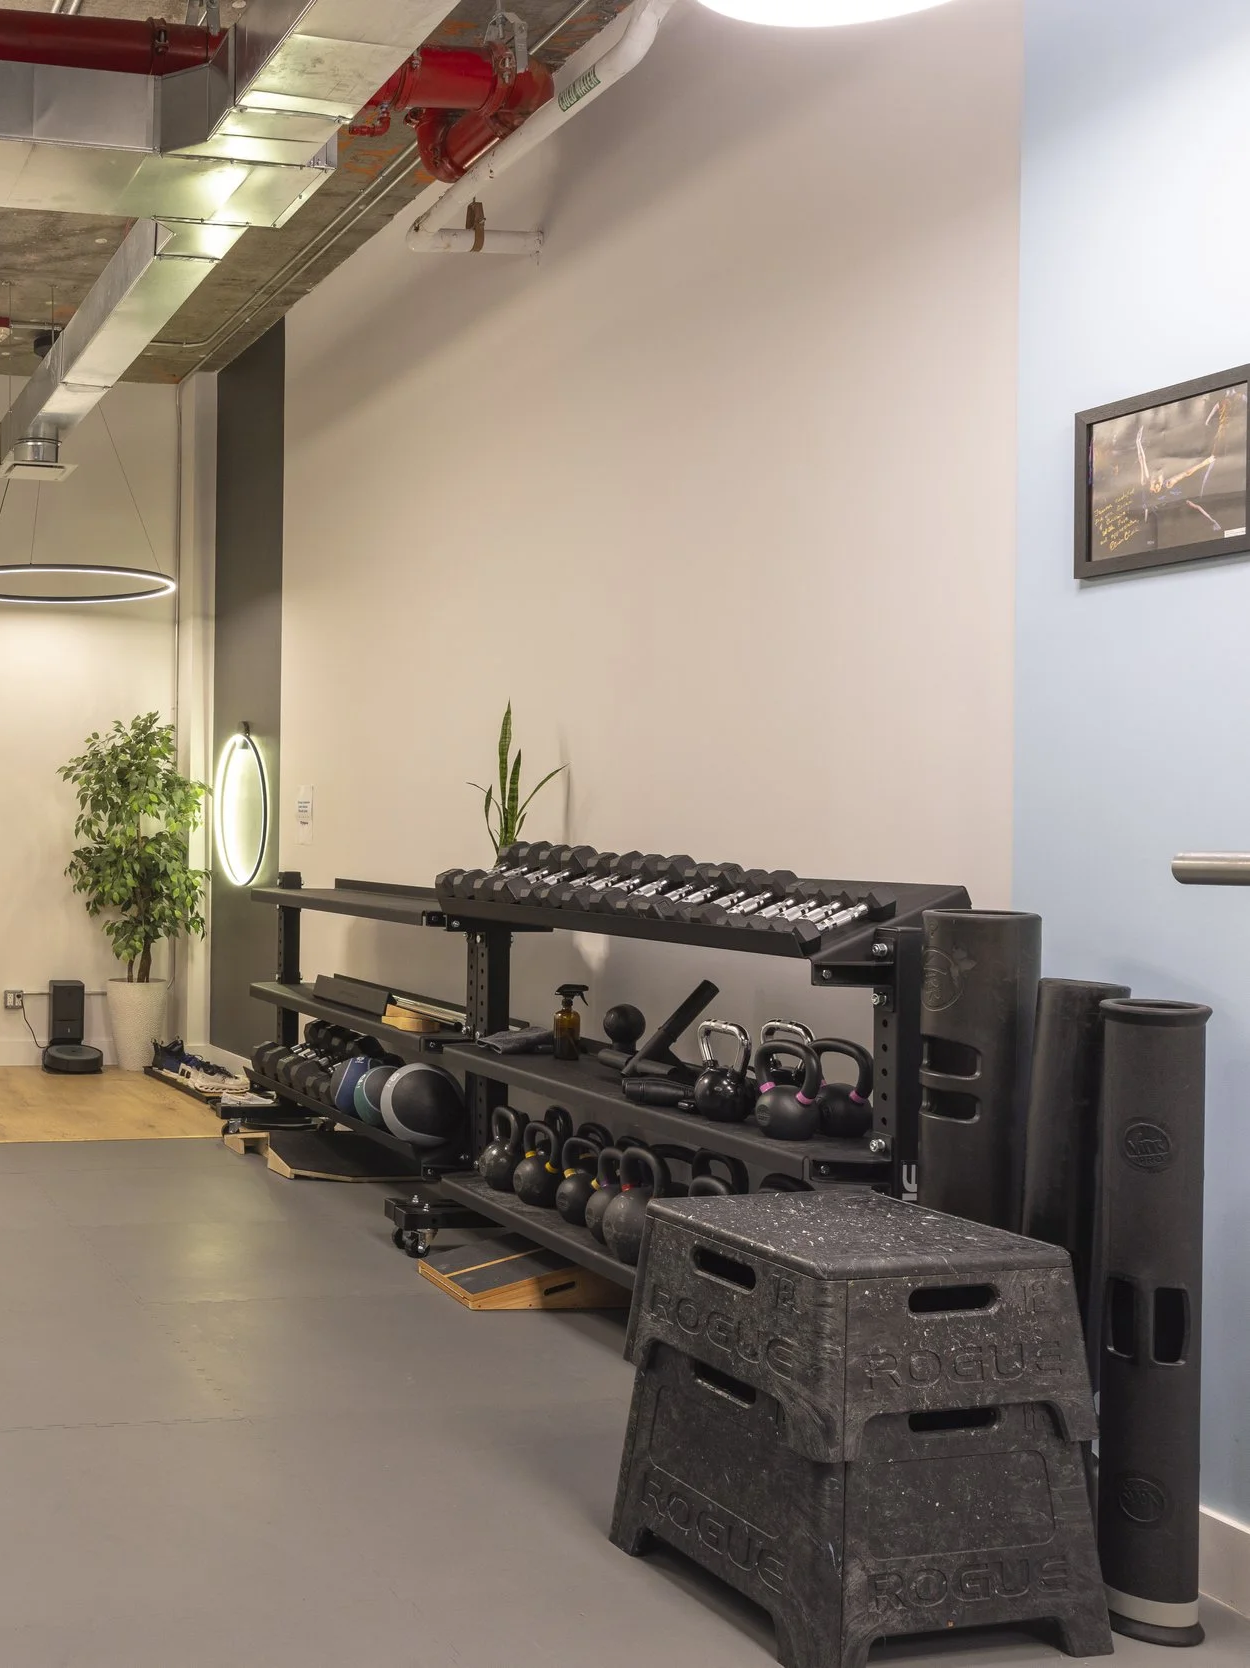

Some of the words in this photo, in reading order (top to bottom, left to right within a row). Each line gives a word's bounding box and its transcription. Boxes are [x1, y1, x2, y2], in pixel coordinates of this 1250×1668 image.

[649, 1284, 799, 1381] ROGUE
[860, 1340, 1063, 1391] ROGUE
[641, 1472, 784, 1595] ROGUE
[867, 1554, 1070, 1613] ROGUE
